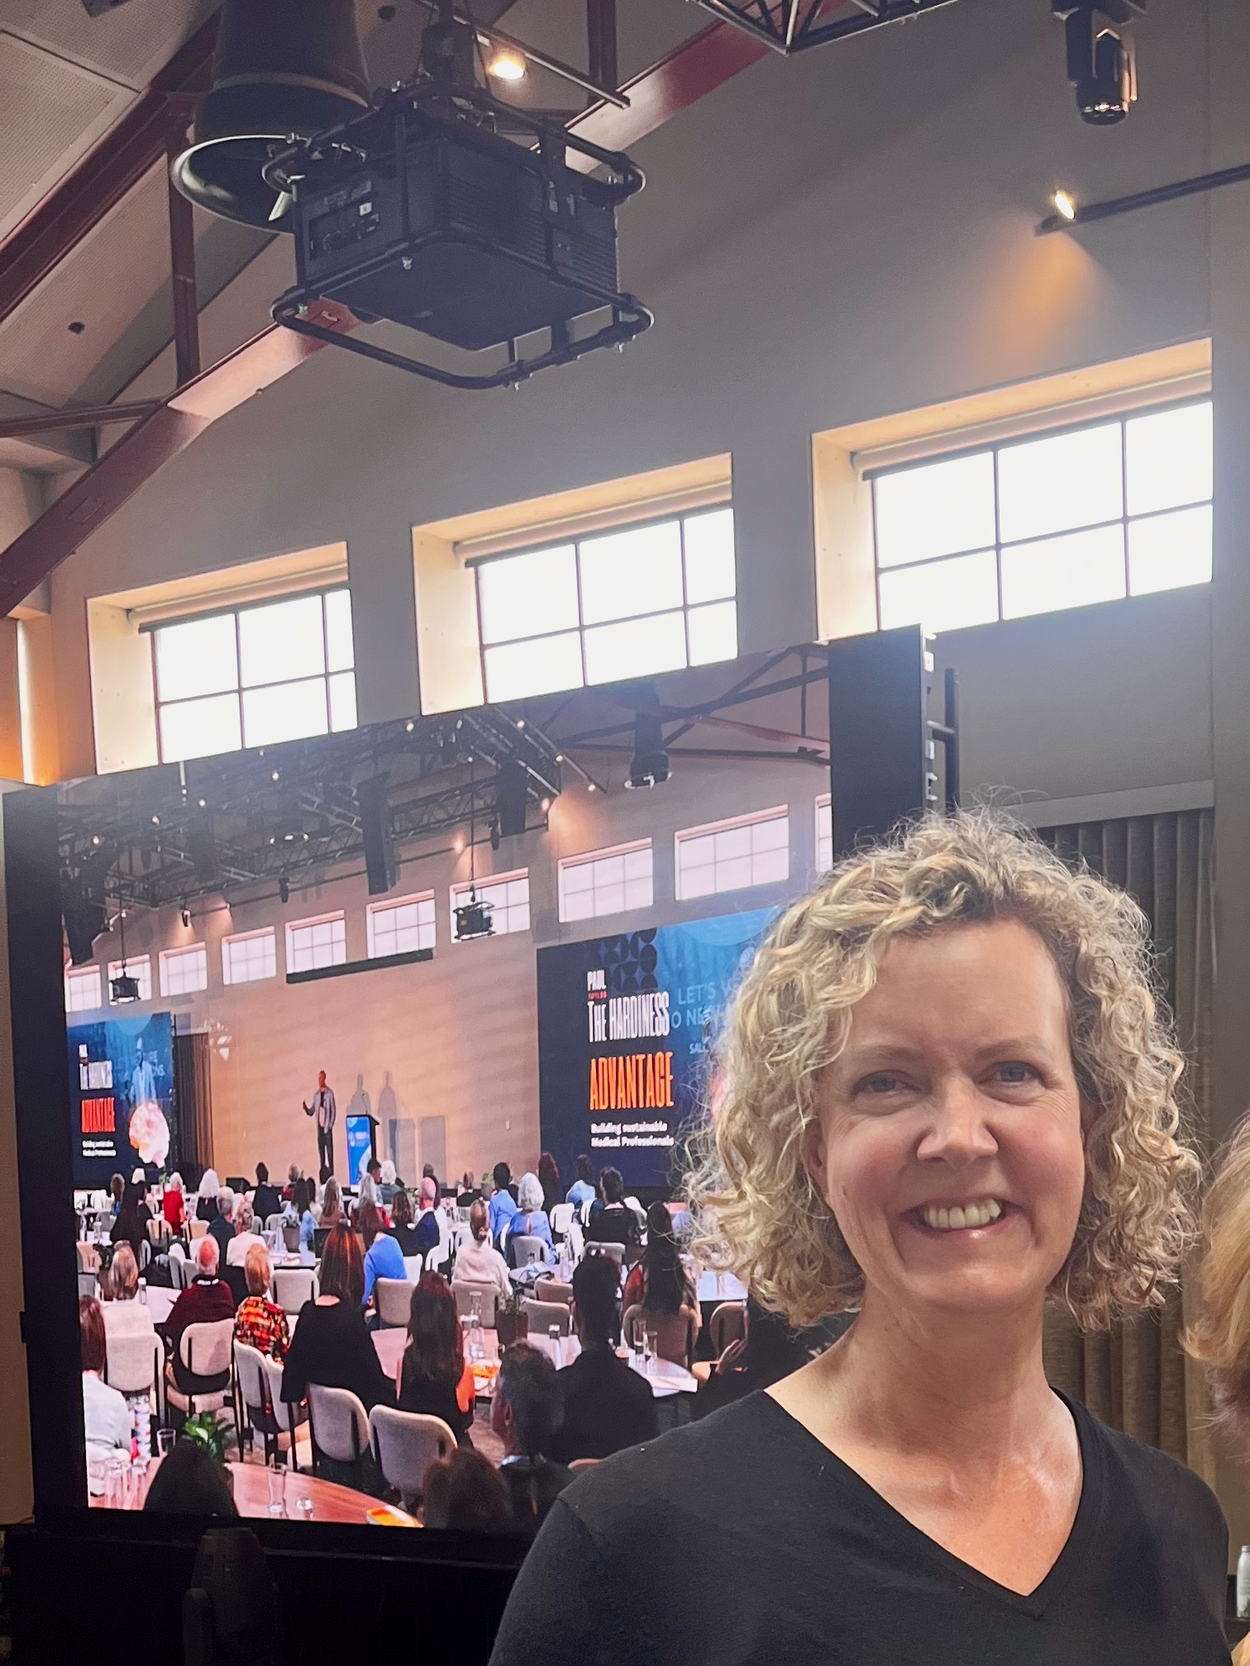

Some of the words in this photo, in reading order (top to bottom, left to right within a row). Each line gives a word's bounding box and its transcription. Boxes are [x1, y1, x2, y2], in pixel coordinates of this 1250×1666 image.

[608, 991, 669, 1040] HARDINESS
[678, 982, 716, 1006] LET'S
[590, 1051, 674, 1110] ADVANTAGE
